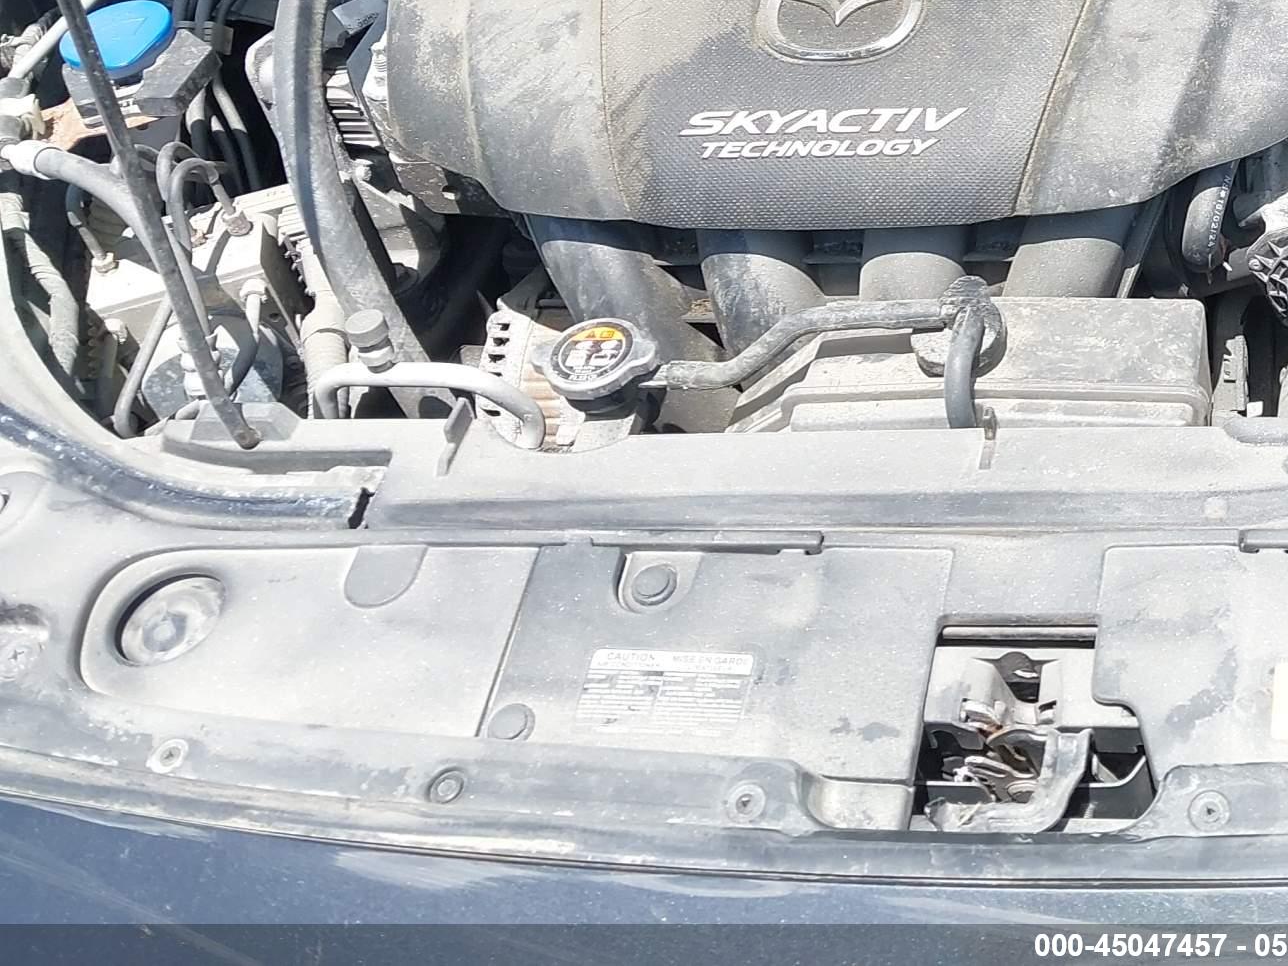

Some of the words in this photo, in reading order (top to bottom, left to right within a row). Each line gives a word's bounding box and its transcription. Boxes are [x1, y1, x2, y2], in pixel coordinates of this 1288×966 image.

[678, 107, 969, 137] SKYACTIV
[700, 138, 941, 159] TECHNOLOGY
[607, 651, 656, 662] CAUTION
